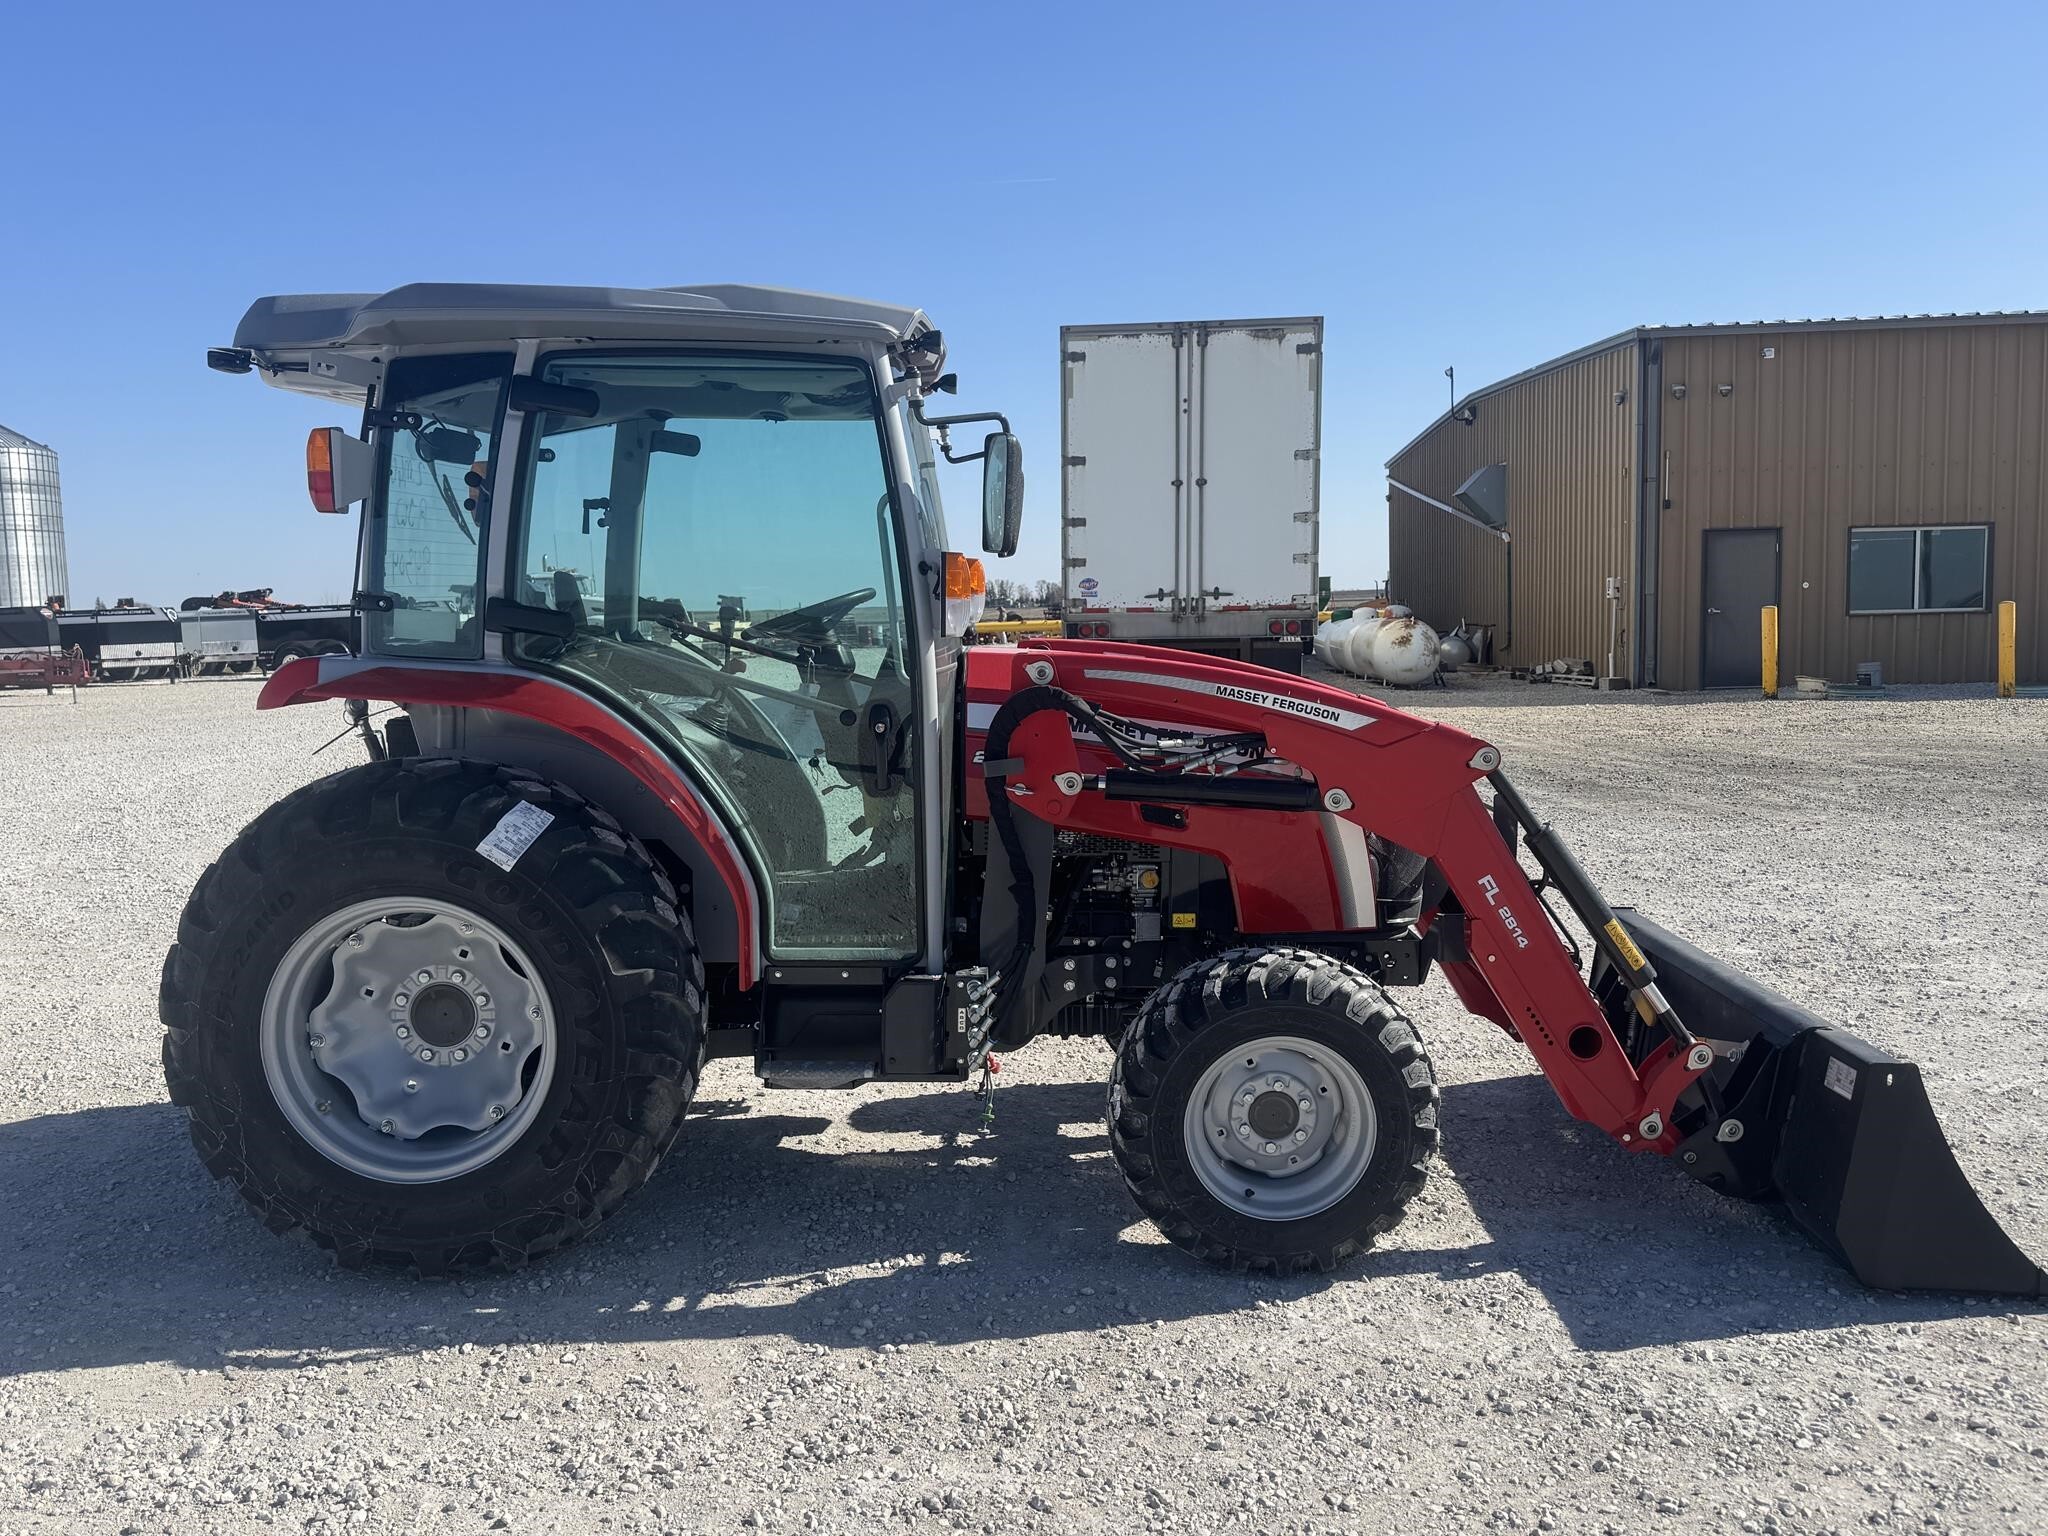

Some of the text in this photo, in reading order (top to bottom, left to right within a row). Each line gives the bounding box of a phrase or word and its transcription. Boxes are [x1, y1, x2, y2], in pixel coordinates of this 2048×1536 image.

[1215, 685, 1341, 722] MASSEY FERGUSON
[1477, 874, 1529, 949] FL 2814
